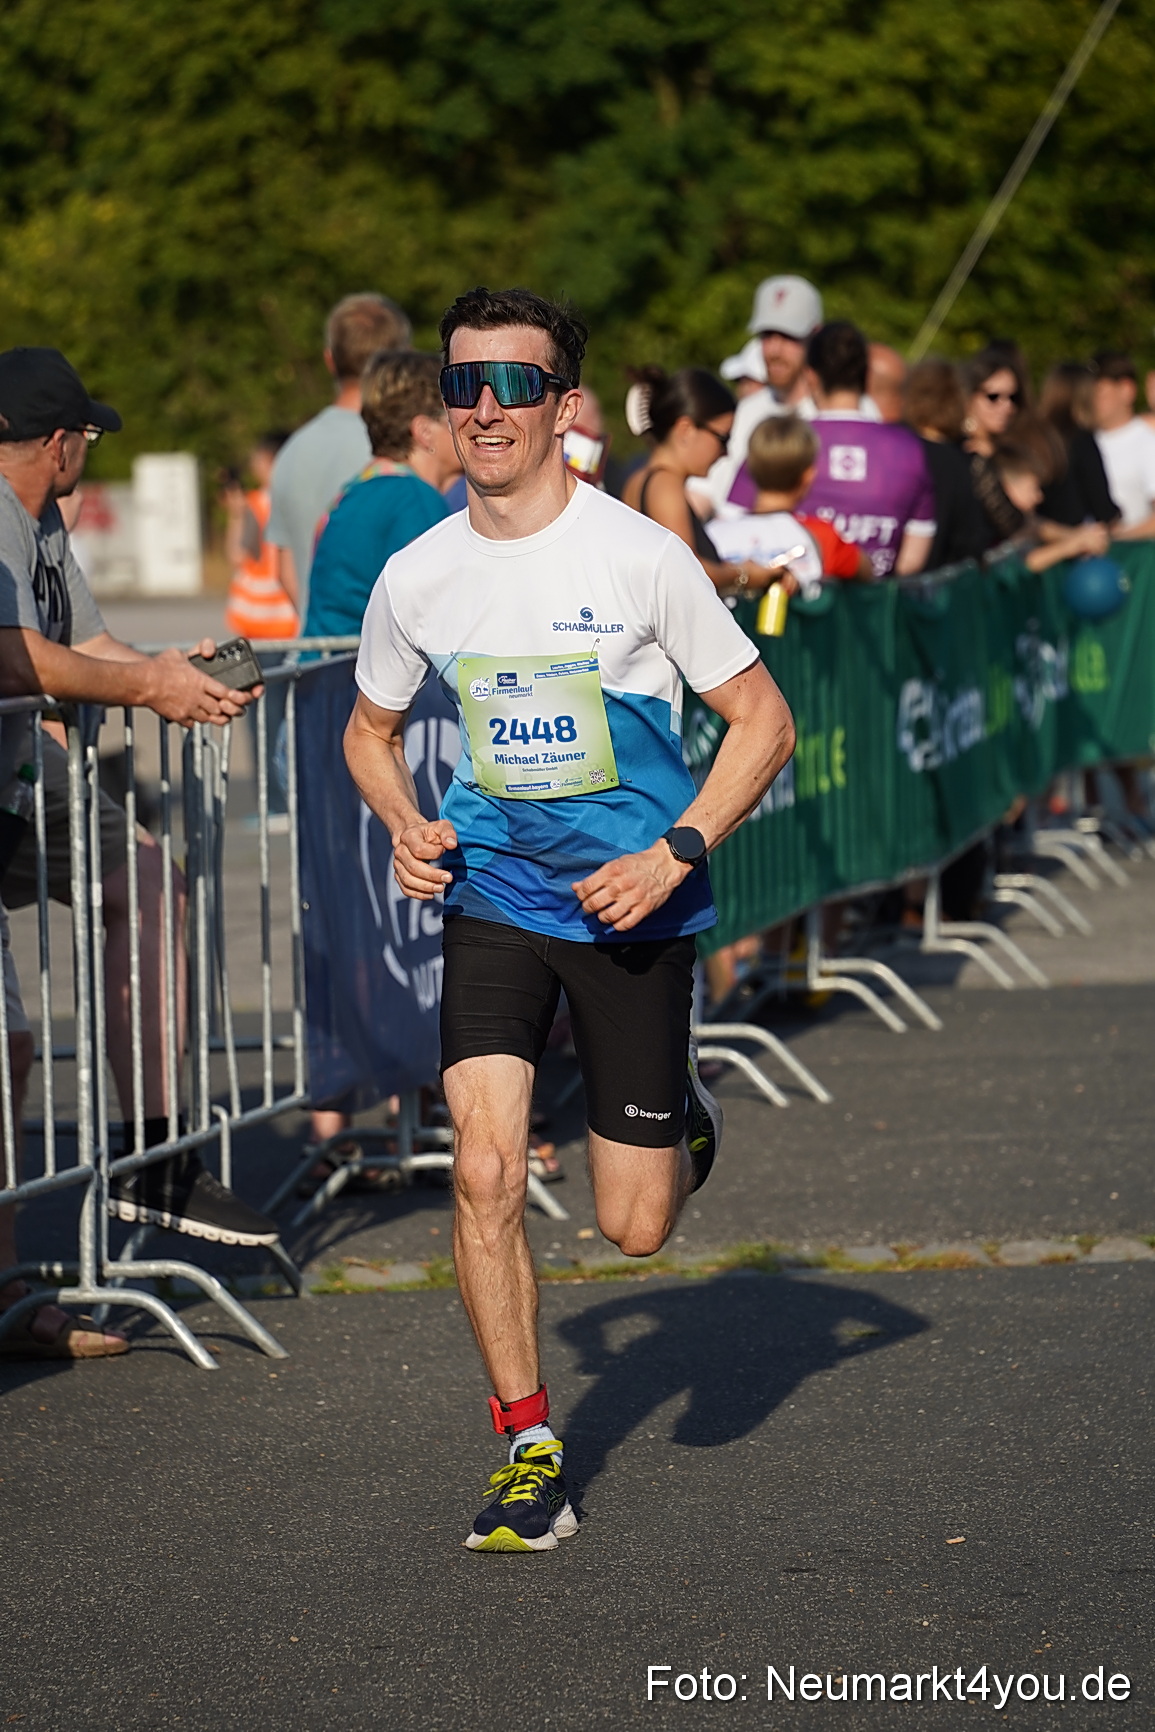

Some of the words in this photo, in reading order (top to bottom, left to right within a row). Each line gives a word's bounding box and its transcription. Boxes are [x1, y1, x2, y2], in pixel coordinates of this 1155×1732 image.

[552, 621, 625, 634] SCHABMÜLLER
[491, 684, 533, 695] Firmenlauf
[488, 715, 578, 745] 2448
[494, 753, 539, 765] Michael
[542, 751, 587, 763] Zäuner
[639, 1109, 672, 1121] benger
